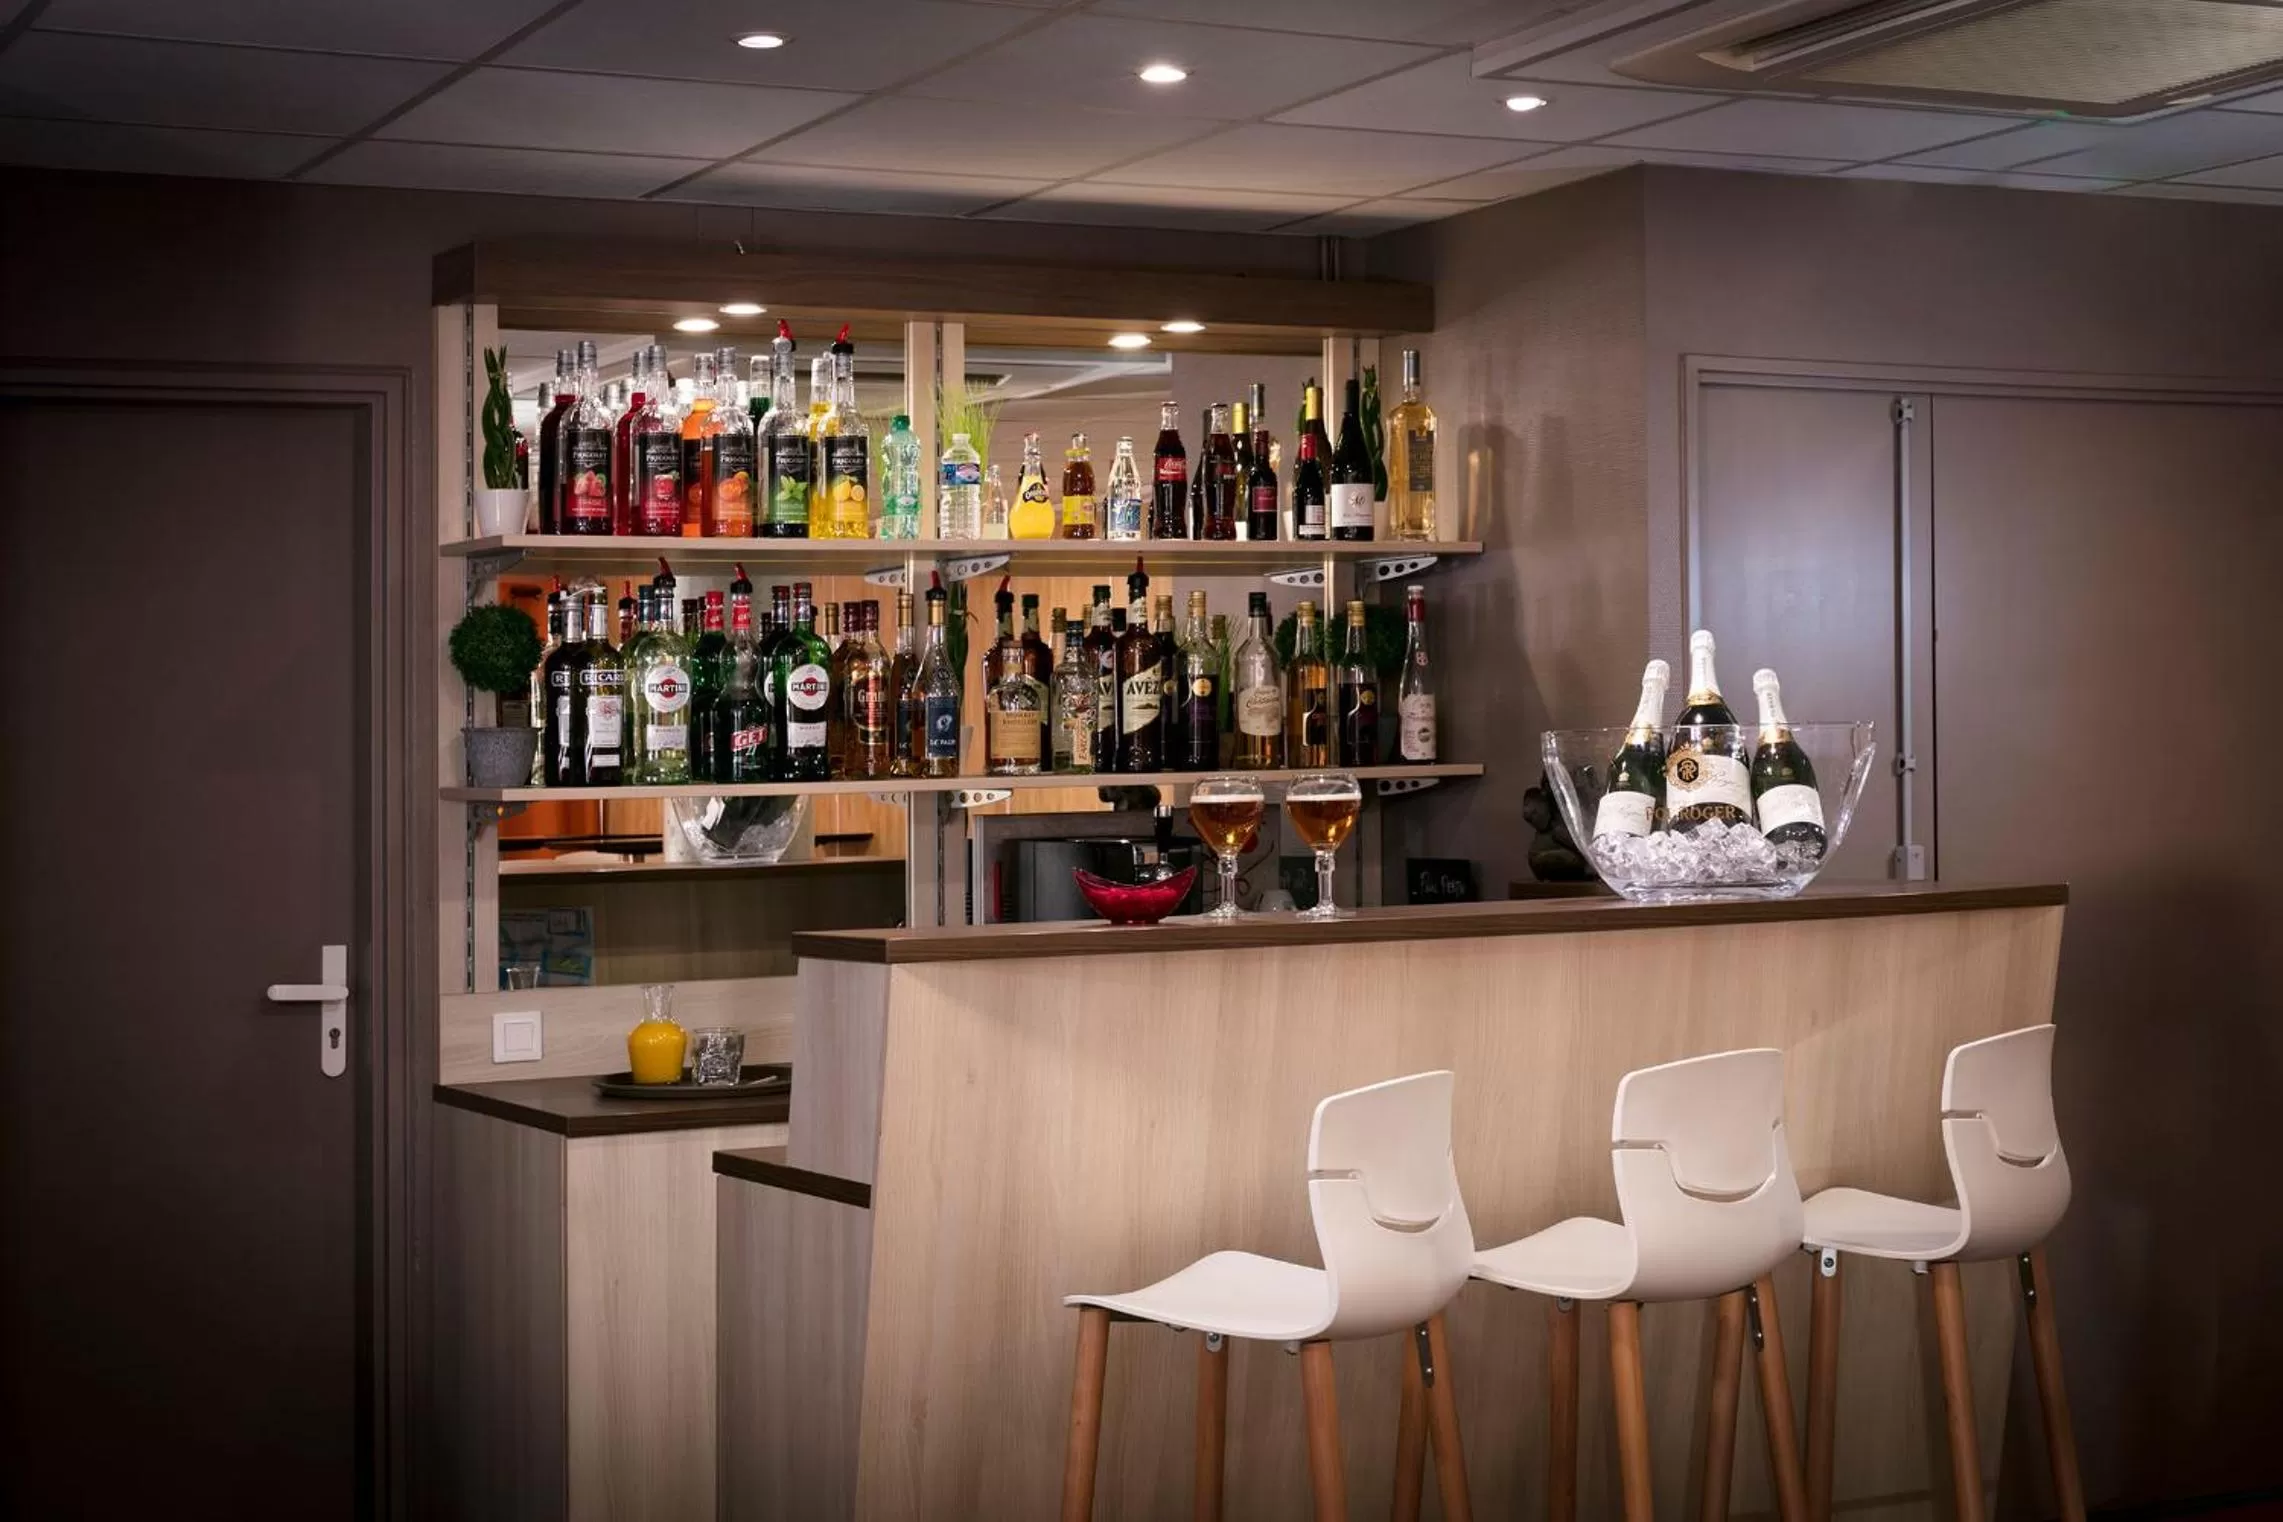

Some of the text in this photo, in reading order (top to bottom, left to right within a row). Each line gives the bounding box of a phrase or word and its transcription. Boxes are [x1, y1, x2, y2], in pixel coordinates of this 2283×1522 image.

[648, 683, 687, 693] MARTINI
[791, 682, 827, 692] MARTINI
[1679, 805, 1737, 820] ROGER
